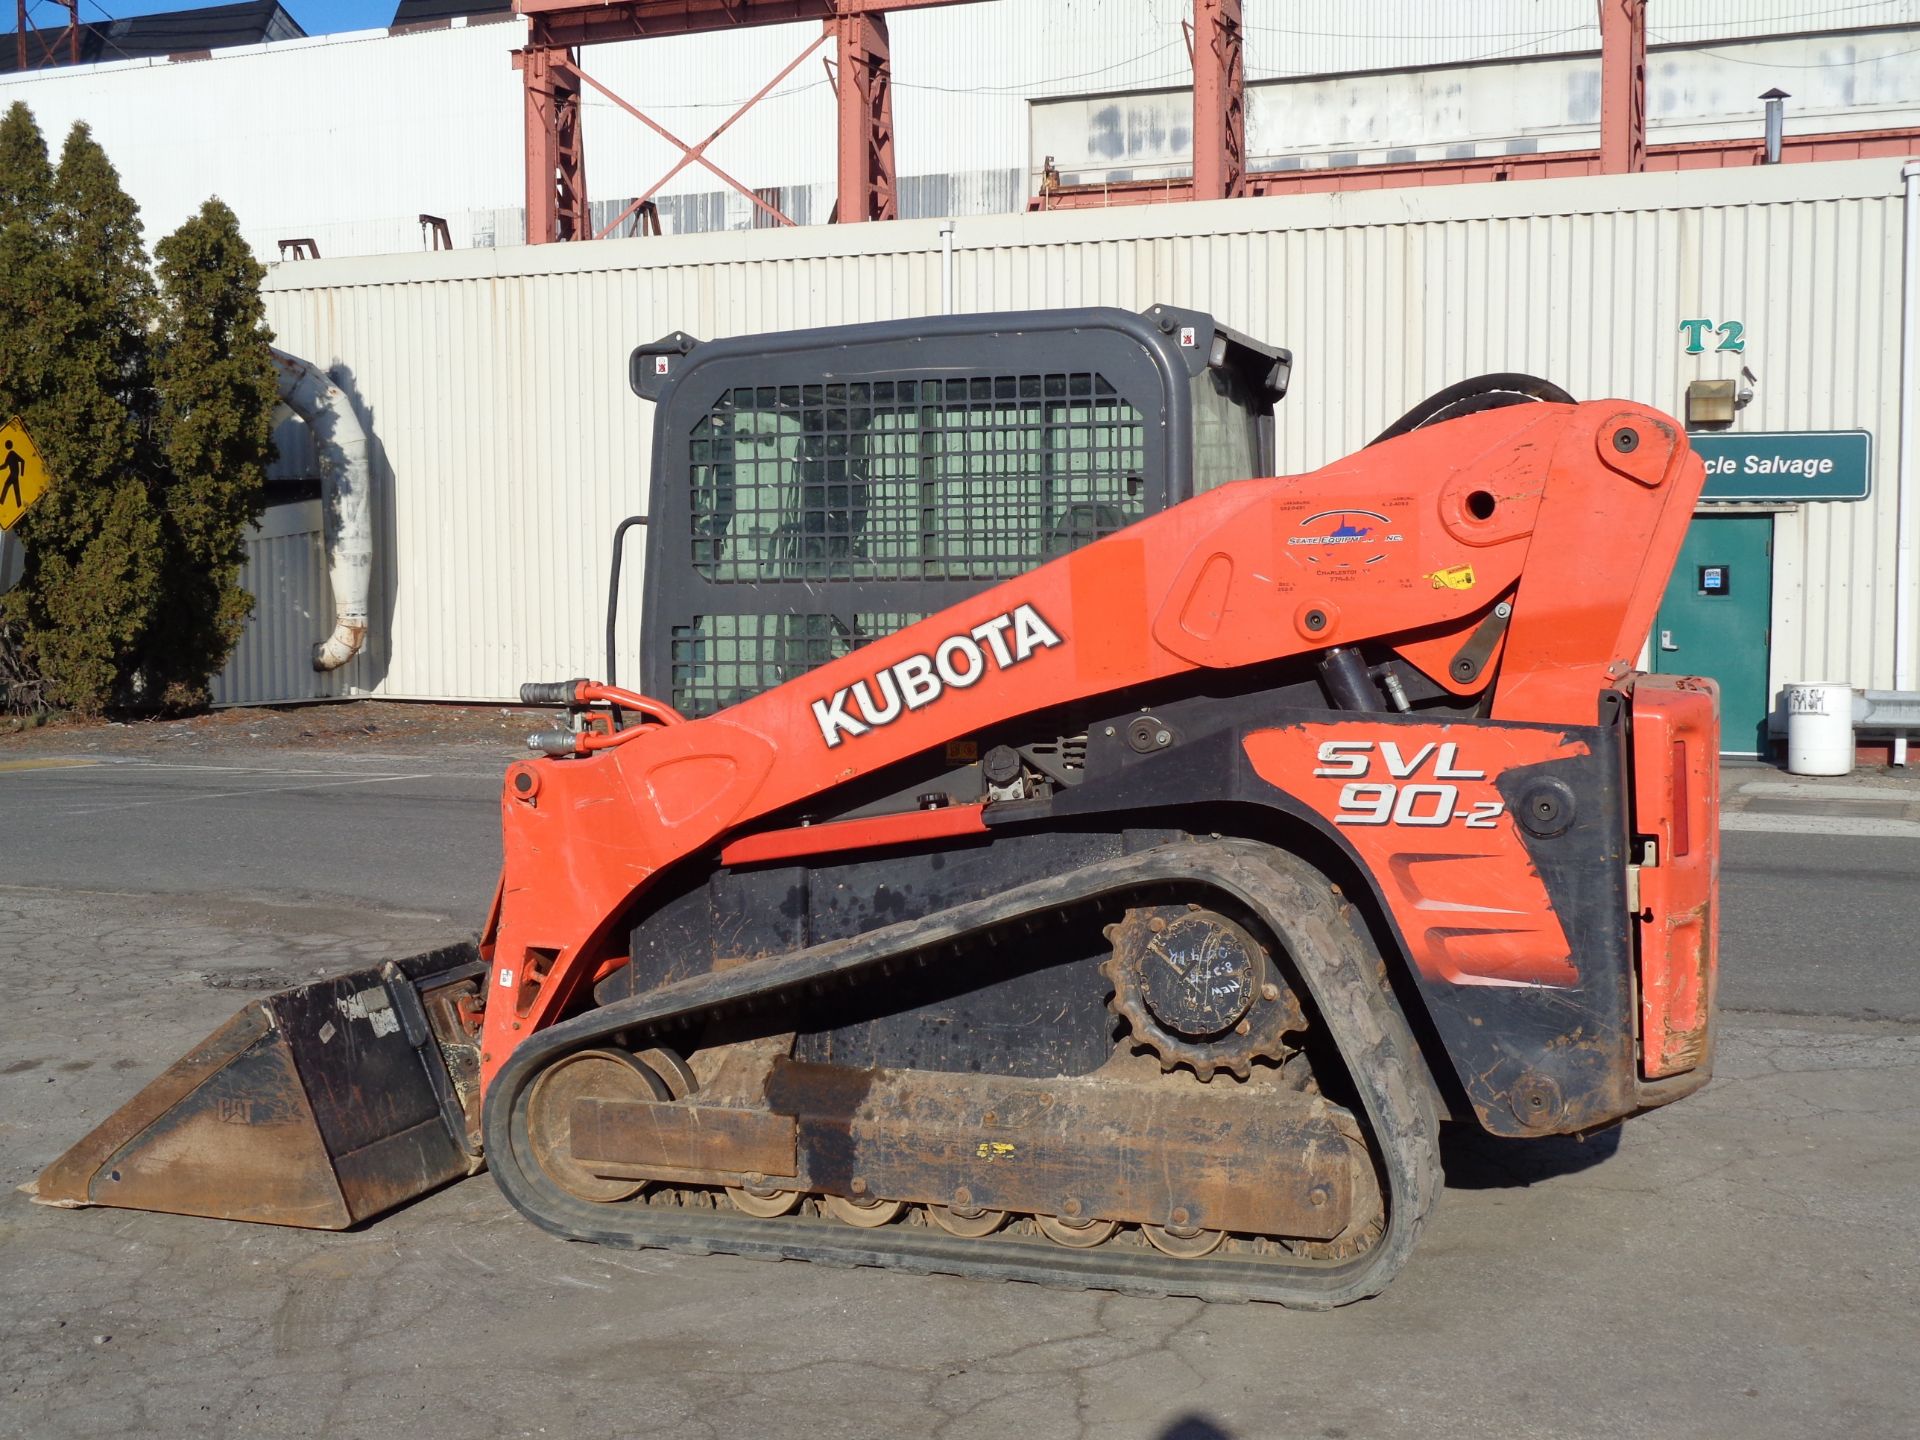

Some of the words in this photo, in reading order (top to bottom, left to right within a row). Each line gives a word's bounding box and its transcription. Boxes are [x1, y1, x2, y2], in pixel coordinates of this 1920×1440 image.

[1679, 319, 1746, 354] T2
[1703, 456, 1737, 475] cle
[1744, 455, 1833, 478] Salvage
[811, 603, 1062, 748] KUBOTA
[1313, 741, 1486, 780] SVL
[1333, 783, 1505, 829] 90-2
[1211, 978, 1240, 1000] NEW
